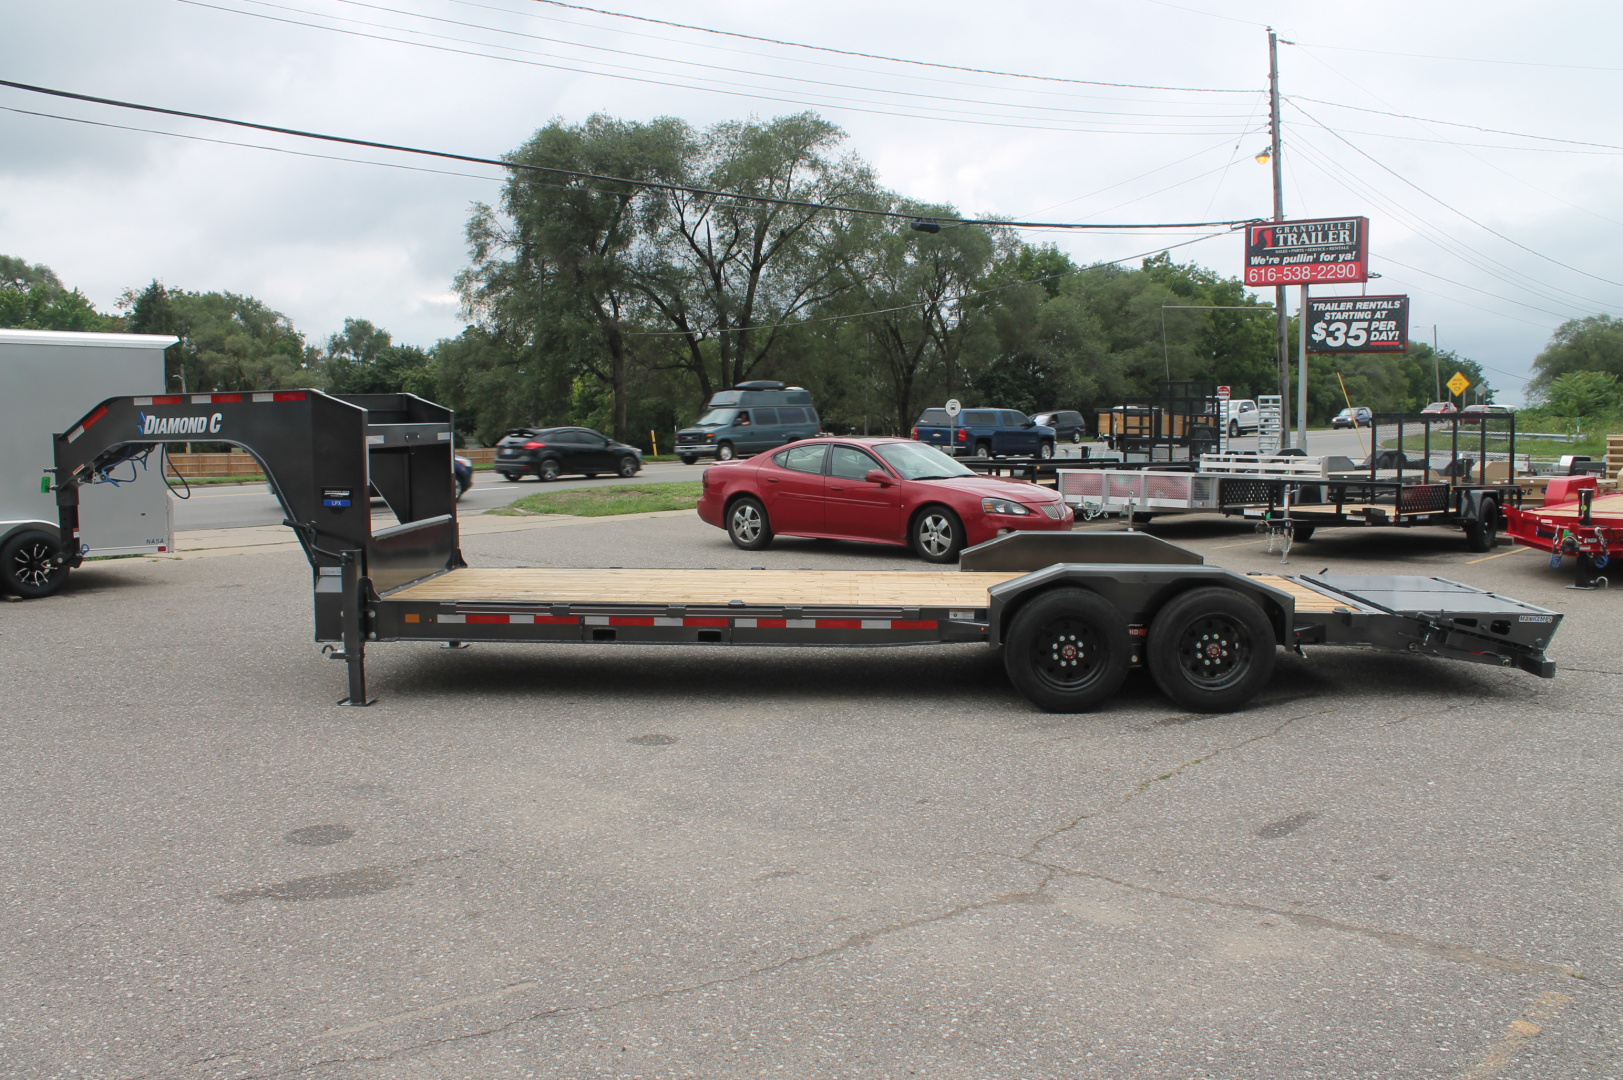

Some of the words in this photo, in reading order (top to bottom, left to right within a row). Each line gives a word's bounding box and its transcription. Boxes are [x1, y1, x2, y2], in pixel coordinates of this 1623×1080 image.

[1276, 222, 1351, 234] GRANDVILLE
[1276, 230, 1350, 246] TRAILER
[1250, 256, 1280, 265] We're
[1282, 253, 1316, 265] pullin'
[1320, 252, 1336, 262] for
[1338, 251, 1356, 262] ya!
[1250, 264, 1356, 282] 616-538-2290
[1312, 302, 1353, 311] TRAILER
[1356, 301, 1400, 309] RENTALS
[1324, 311, 1372, 320] STARTING
[1311, 320, 1369, 347] $35
[1370, 321, 1396, 330] PER
[1370, 331, 1400, 341] DAY!
[144, 415, 207, 434] DIAMOND
[210, 413, 222, 434] C
